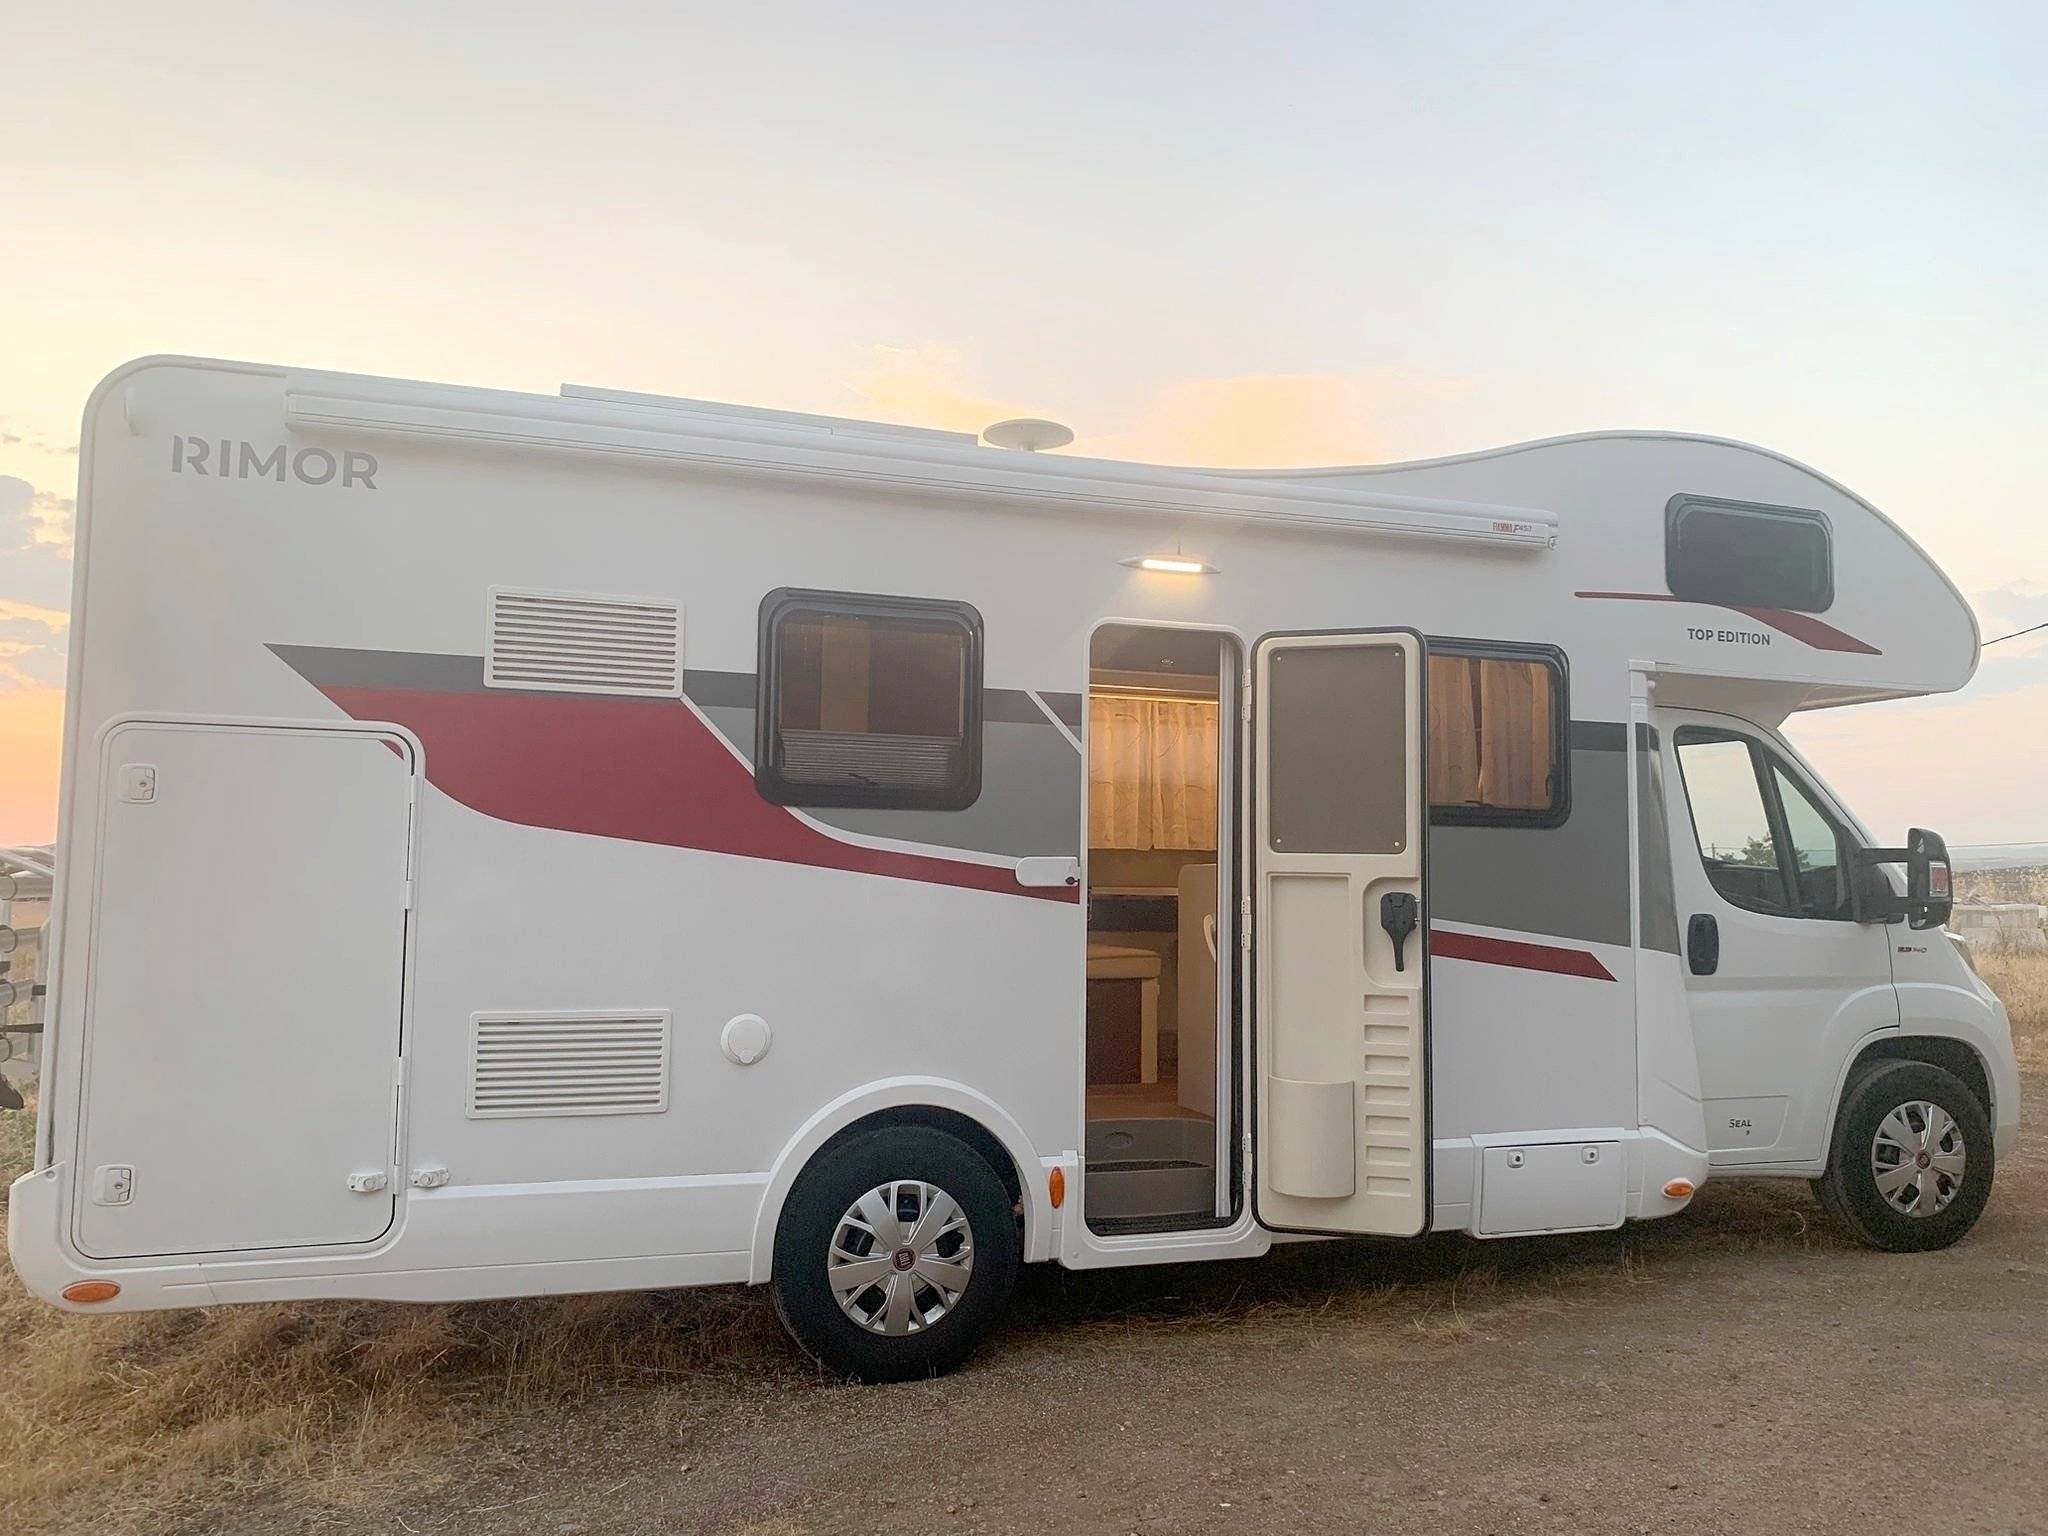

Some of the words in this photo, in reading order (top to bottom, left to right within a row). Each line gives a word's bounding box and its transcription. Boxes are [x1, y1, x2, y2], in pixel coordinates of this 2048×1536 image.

[172, 435, 378, 489] RIMOR
[1687, 628, 1714, 641] TOP
[1717, 630, 1770, 645] EDITION
